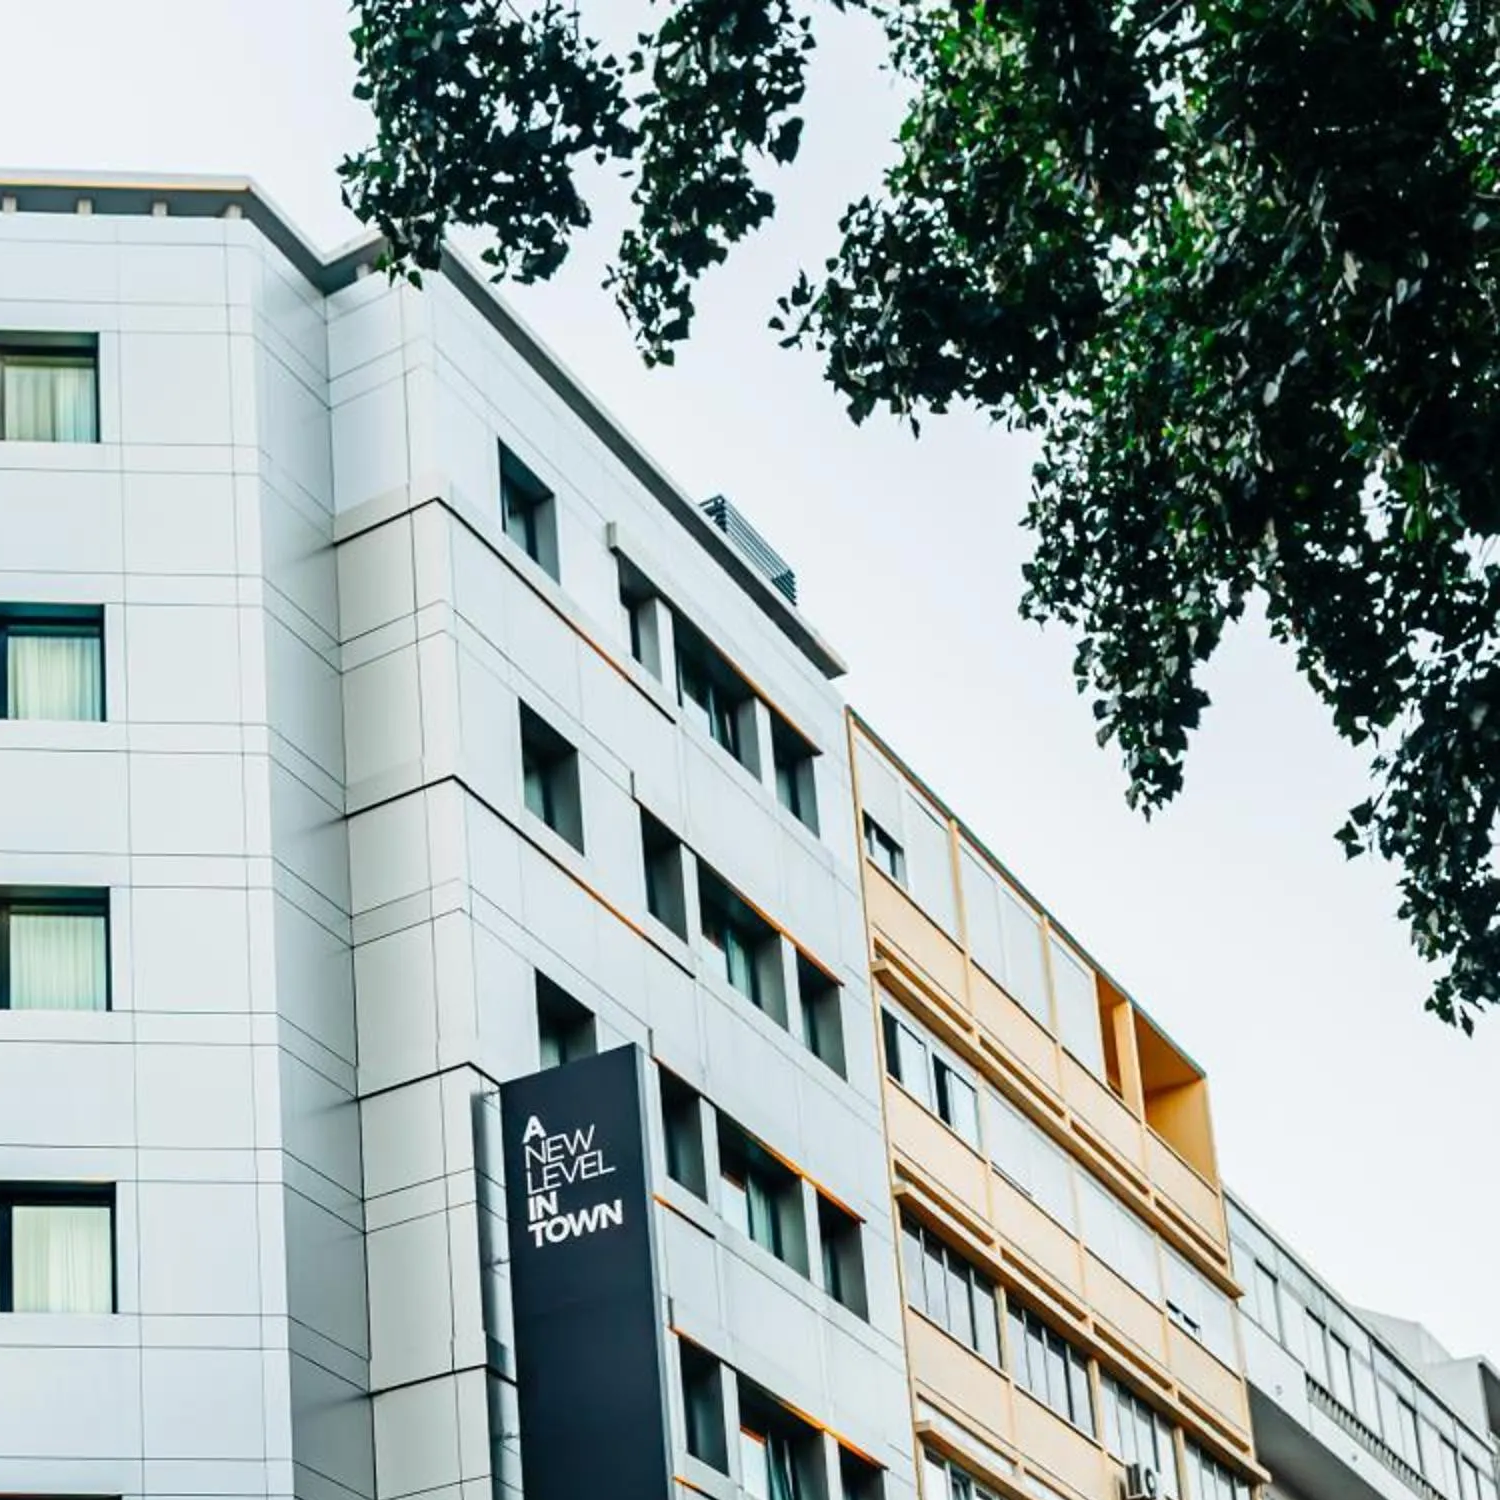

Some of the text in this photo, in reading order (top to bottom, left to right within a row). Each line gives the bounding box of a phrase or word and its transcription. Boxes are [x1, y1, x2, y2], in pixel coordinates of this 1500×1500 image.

[523, 1115, 547, 1144] A
[525, 1124, 595, 1169] NEW
[527, 1149, 617, 1194] LEVEL
[528, 1199, 623, 1248] TOWN
[529, 1190, 559, 1222] IN
